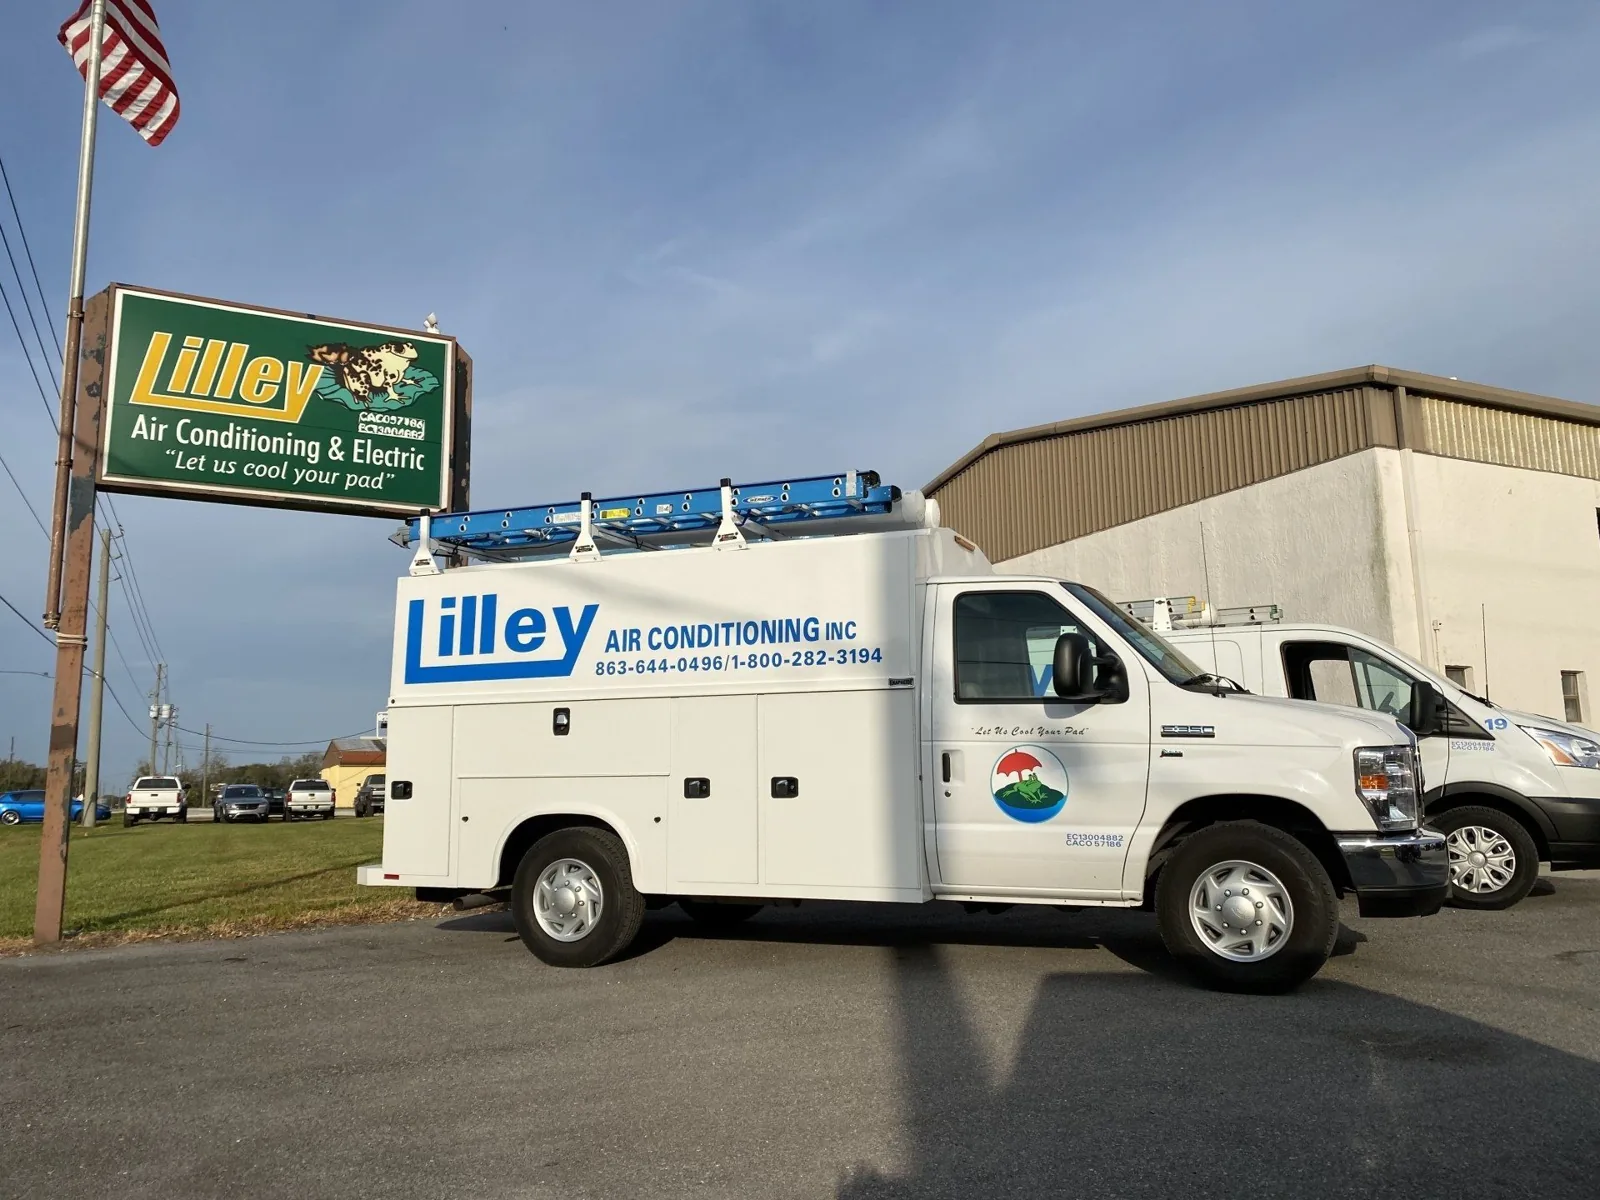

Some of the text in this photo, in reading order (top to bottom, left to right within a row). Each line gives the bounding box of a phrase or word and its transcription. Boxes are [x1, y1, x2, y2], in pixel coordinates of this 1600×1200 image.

[129, 331, 324, 423] Lilley
[131, 413, 425, 471] Air Conditioning & Electric
[213, 459, 237, 474] us
[243, 461, 289, 480] cool
[292, 467, 340, 485] your
[404, 593, 600, 684] Lilley
[604, 616, 857, 653] AIR CONDITIONING INC
[595, 647, 883, 676] 863-644-0496/1-800-282-3194
[994, 726, 1008, 735] Us
[1011, 726, 1034, 736] Cool
[1037, 726, 1060, 737] Your
[1484, 718, 1508, 731] 19
[1066, 833, 1124, 841] EC13004882
[1094, 840, 1122, 848] 57186
